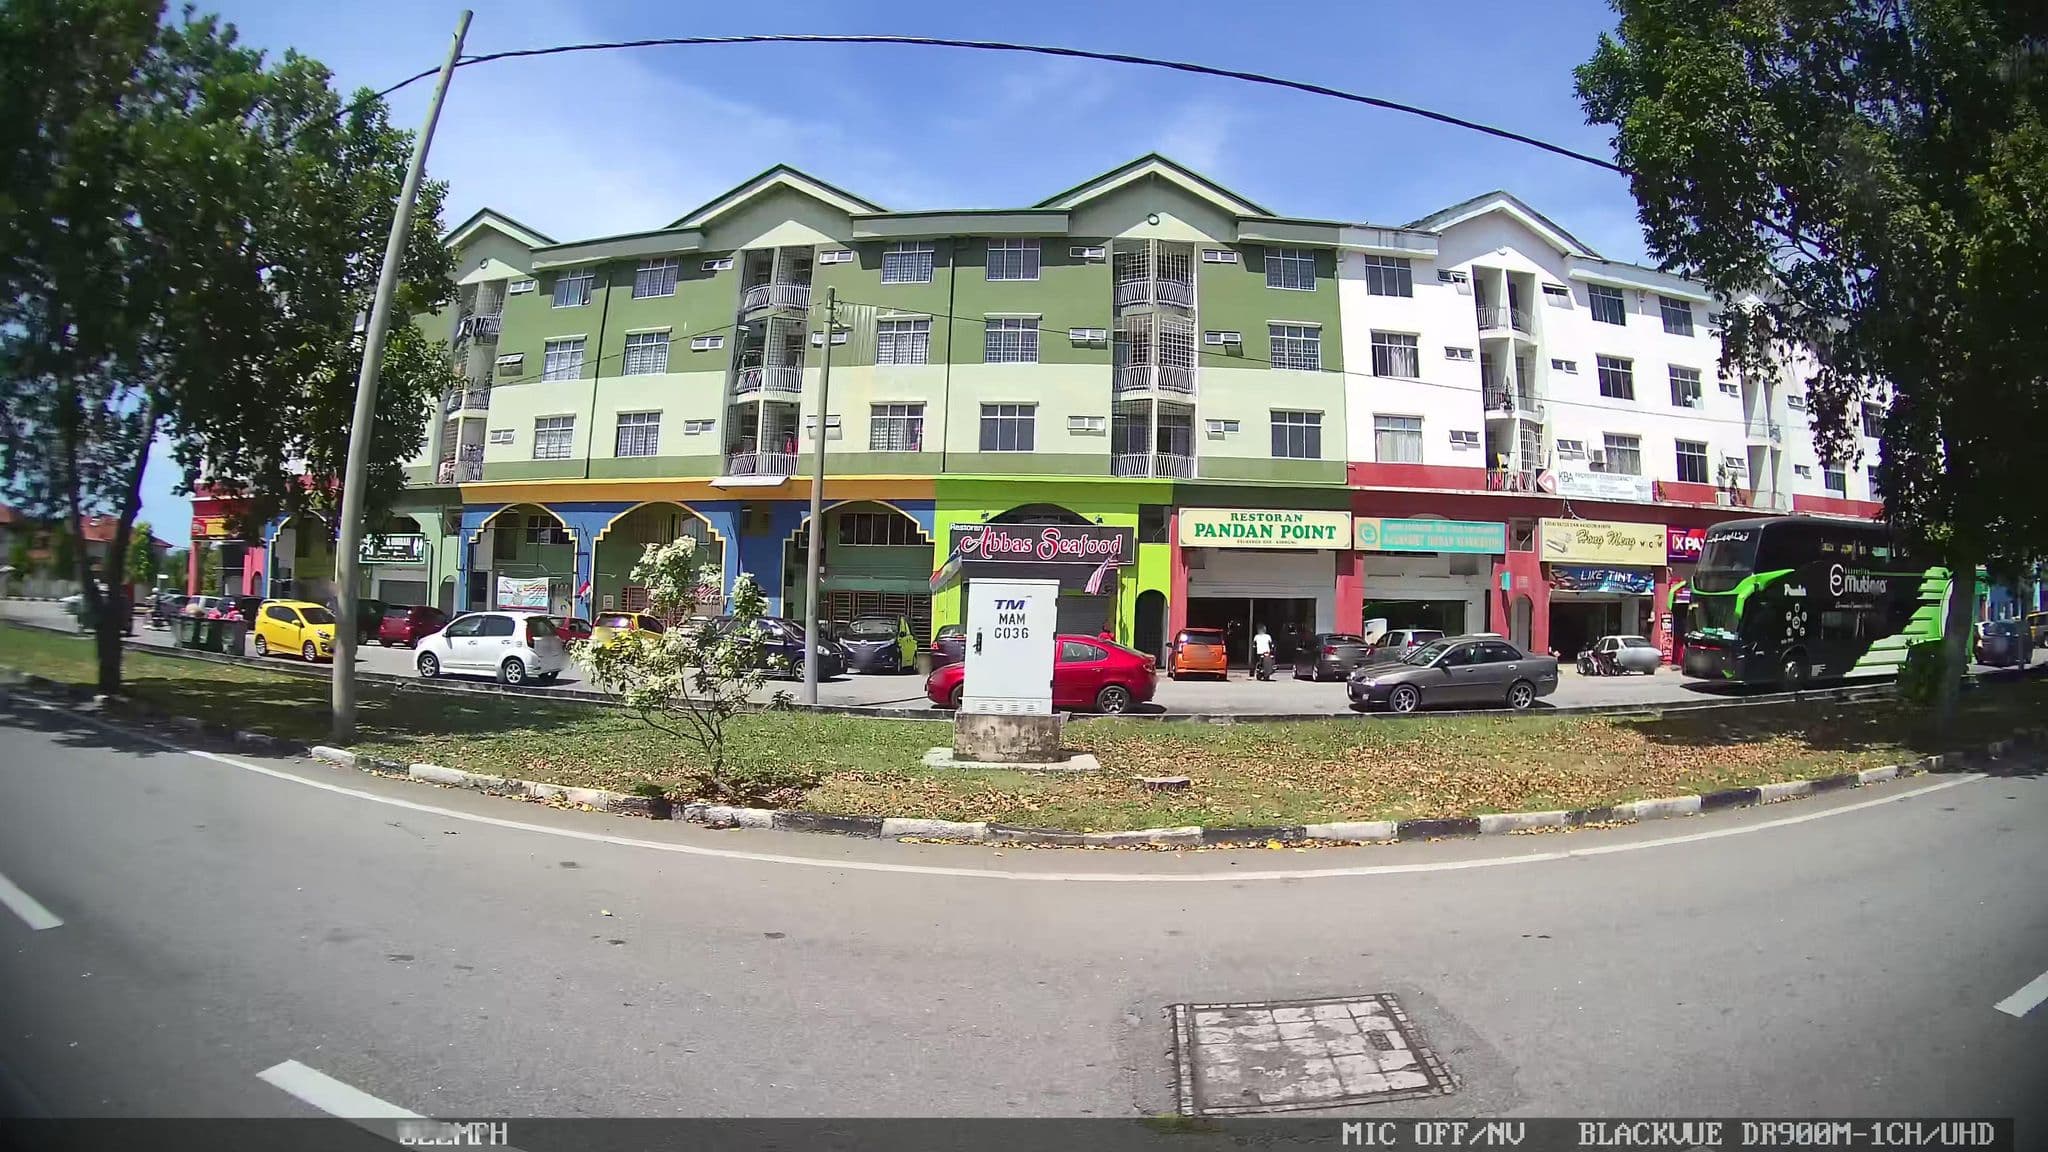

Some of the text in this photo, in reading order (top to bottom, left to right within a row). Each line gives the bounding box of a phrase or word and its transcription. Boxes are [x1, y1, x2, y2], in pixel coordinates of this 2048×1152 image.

[1230, 512, 1303, 523] RESTORAN
[950, 523, 984, 532] Restoran
[1194, 523, 1337, 540] PANDAN POINT
[960, 526, 1123, 561] Abbas Seafood
[1580, 569, 1634, 583] LIKE TINT
[994, 599, 1026, 610] TM
[999, 612, 1026, 625] MAM
